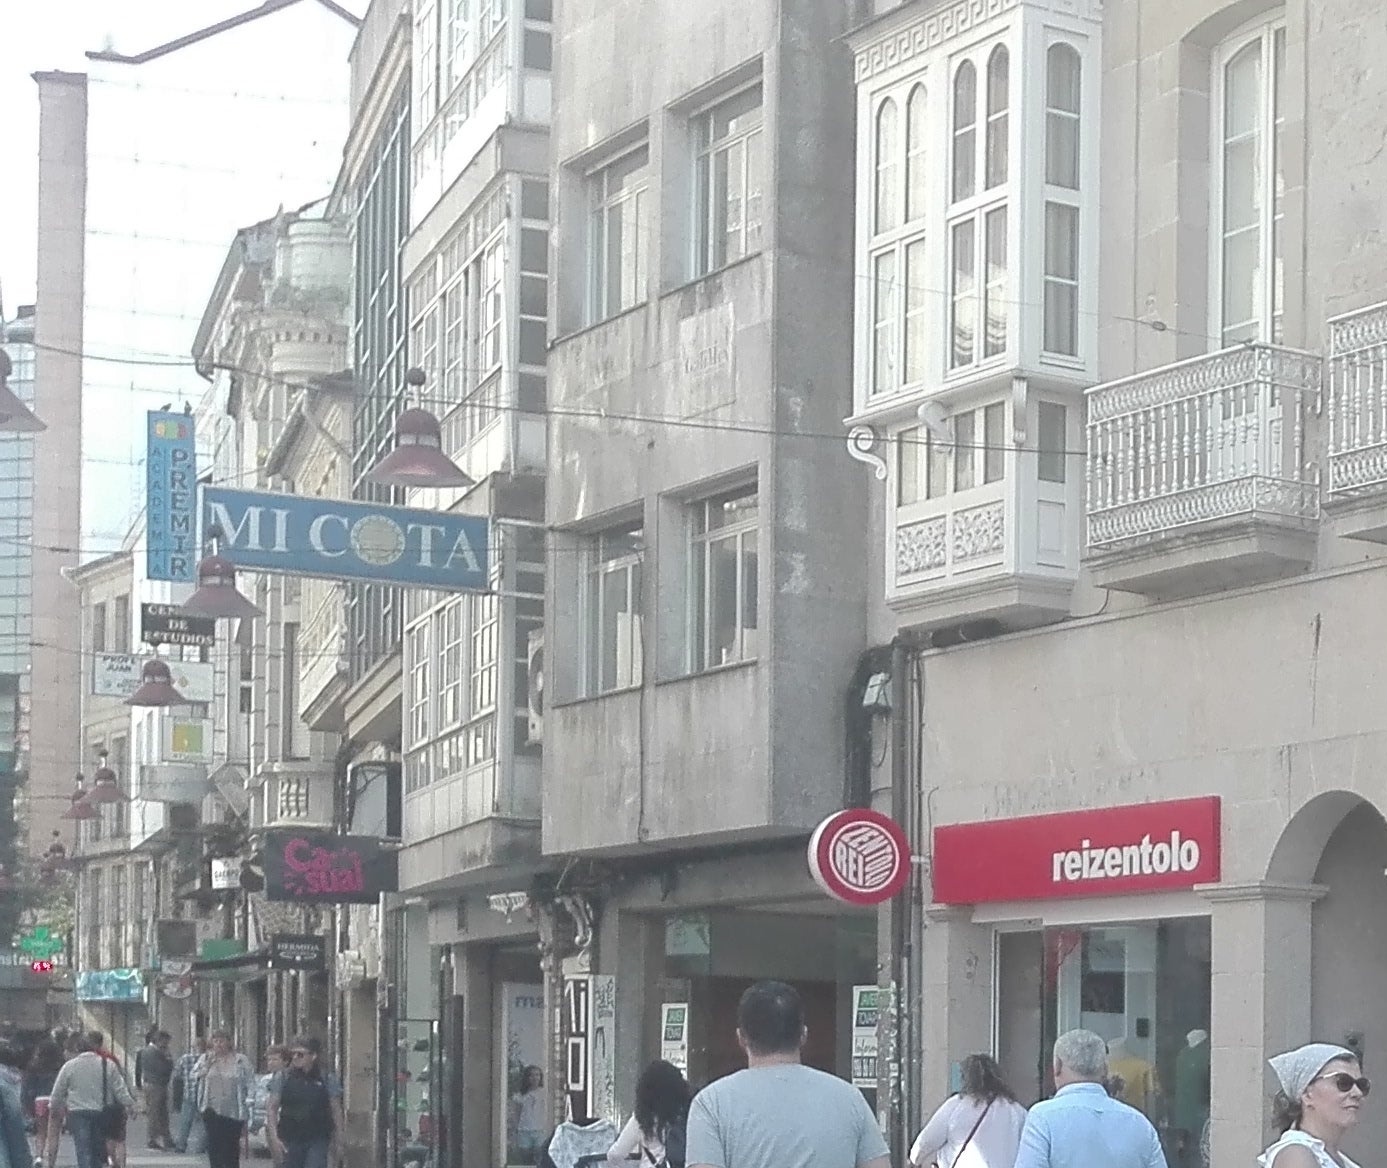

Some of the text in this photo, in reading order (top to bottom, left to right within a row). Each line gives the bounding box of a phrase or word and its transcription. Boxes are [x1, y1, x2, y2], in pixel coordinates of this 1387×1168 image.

[209, 502, 291, 552] MI
[144, 631, 214, 645] ESTUDIOS
[168, 619, 188, 630] DE
[1052, 830, 1200, 882] reizentolo
